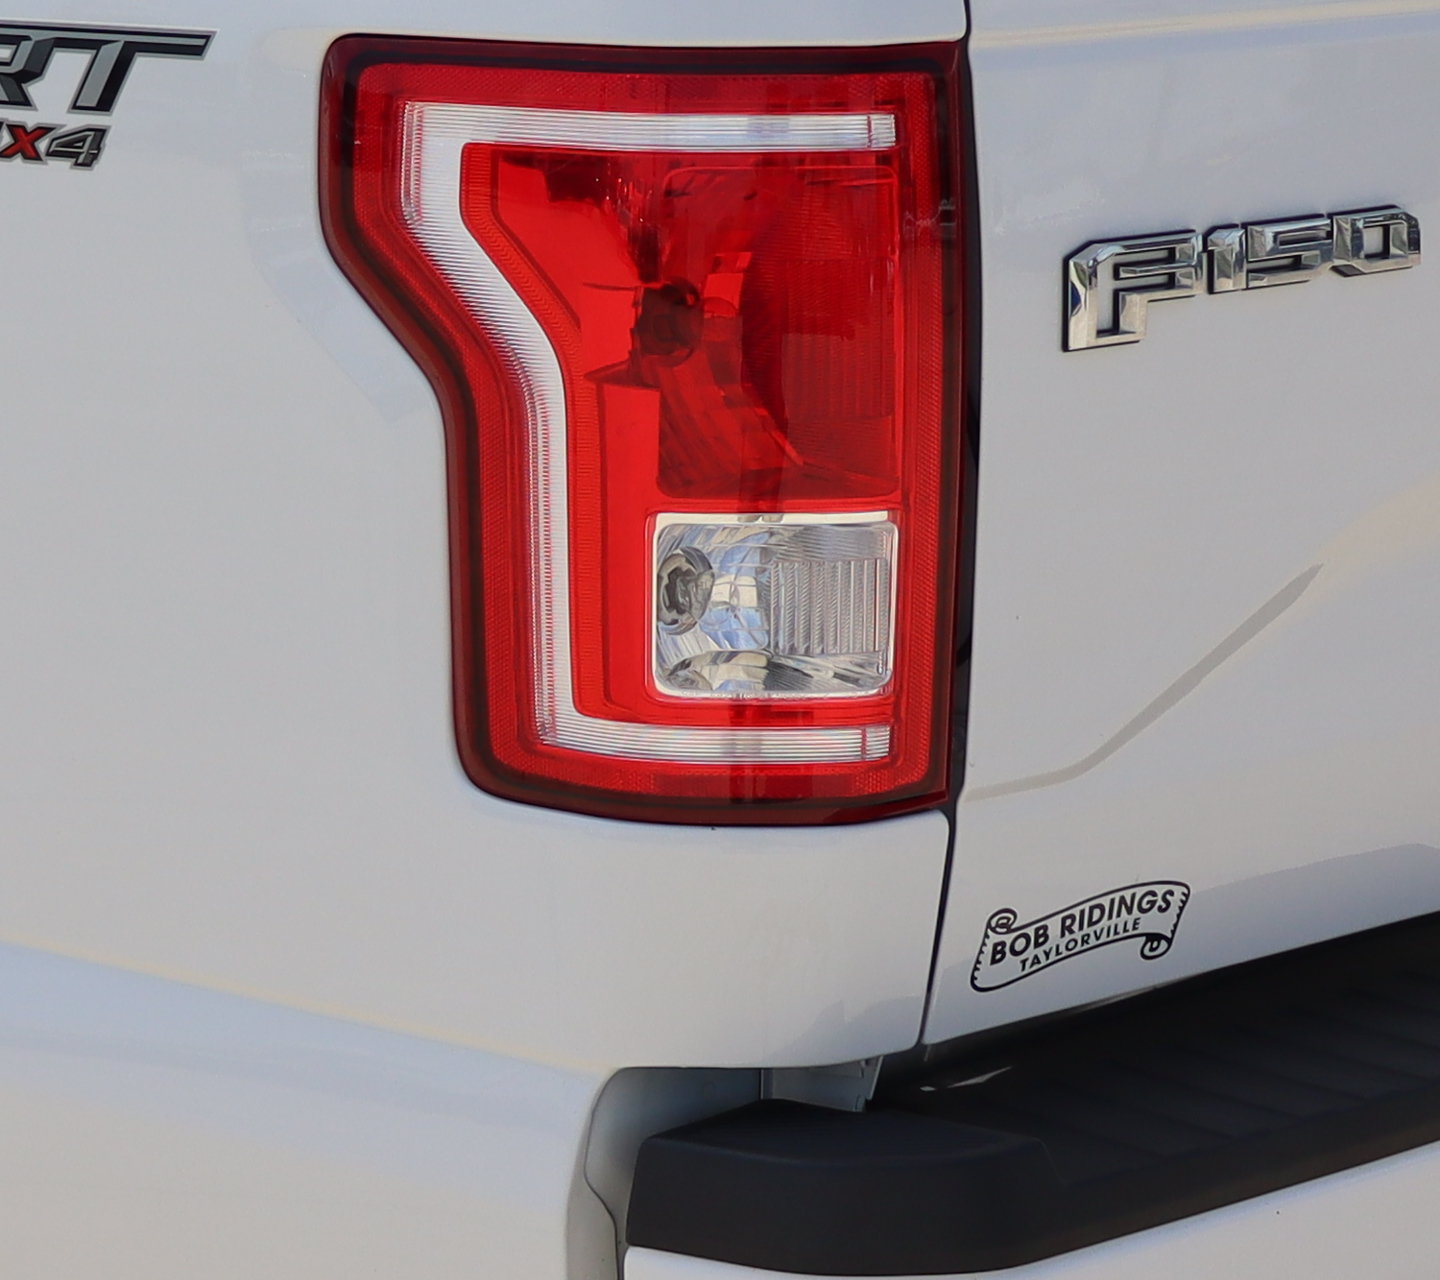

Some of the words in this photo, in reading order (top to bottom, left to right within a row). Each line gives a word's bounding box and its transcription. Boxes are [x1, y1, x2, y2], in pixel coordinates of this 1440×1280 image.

[989, 922, 1050, 966] BOB
[1060, 888, 1175, 939] RIDINGS
[1019, 917, 1142, 972] TAYLORVILLE
